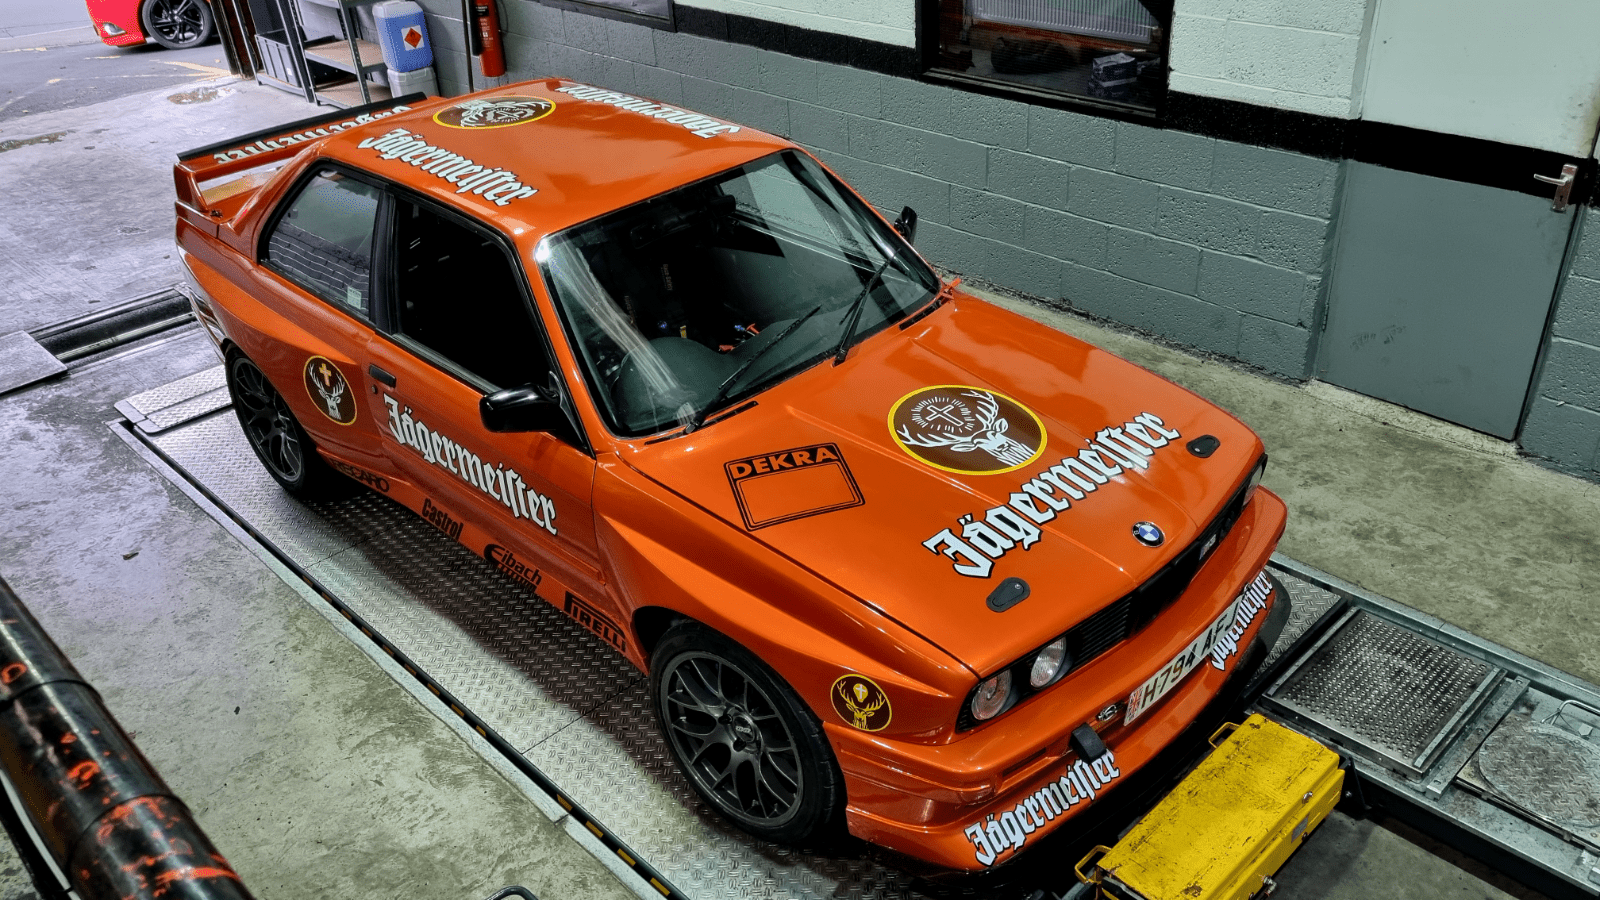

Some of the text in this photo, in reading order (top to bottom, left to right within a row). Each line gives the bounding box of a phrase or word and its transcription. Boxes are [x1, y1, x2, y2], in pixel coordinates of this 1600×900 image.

[729, 447, 839, 480] DEKRA
[421, 497, 464, 541] Castrol
[483, 543, 543, 590] Eibach
[563, 590, 627, 653] PIRELLI
[1140, 643, 1199, 709] H794
